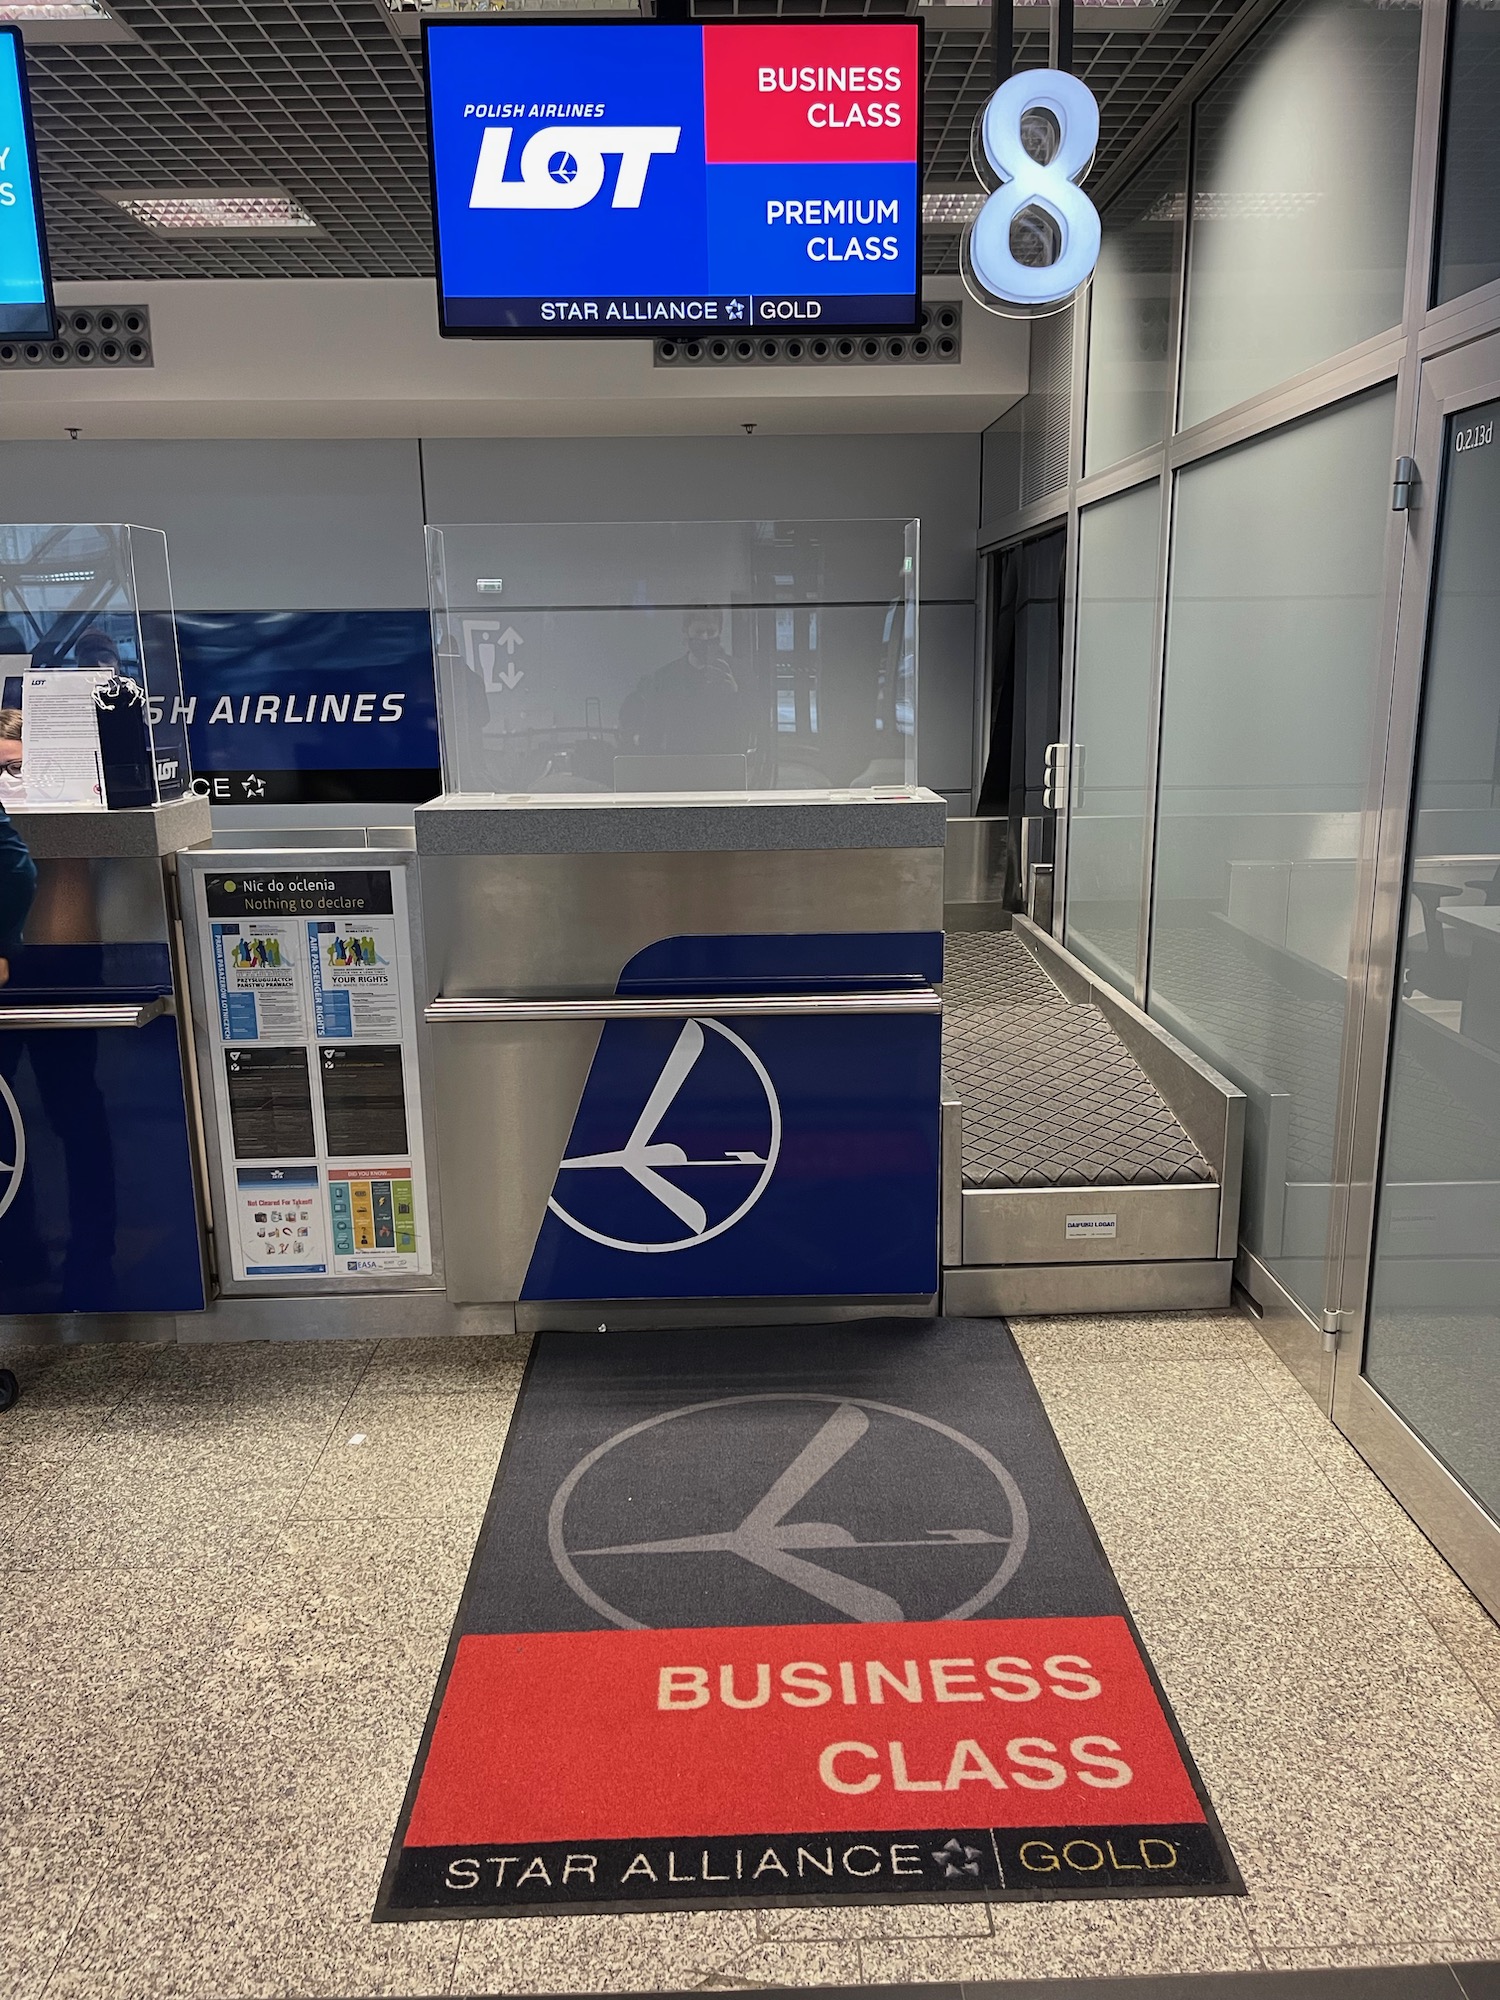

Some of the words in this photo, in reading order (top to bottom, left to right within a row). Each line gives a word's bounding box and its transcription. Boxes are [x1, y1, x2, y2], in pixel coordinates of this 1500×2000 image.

[758, 66, 902, 92] BUSINESS
[463, 103, 525, 118] POLISH
[528, 103, 606, 118] AIRLINES
[806, 102, 902, 128] CLASS
[468, 125, 682, 210] LOT
[970, 67, 1102, 305] 8
[766, 199, 899, 225] PREMIUM
[806, 235, 899, 261] CLASS
[540, 301, 600, 321] STAR
[605, 301, 719, 321] ALLIANCE
[759, 300, 822, 320] GOLD
[1455, 420, 1493, 452] 0.2.13d
[208, 692, 406, 724] AIRLINES
[242, 880, 265, 893] Nic
[267, 879, 285, 892] do
[288, 878, 336, 891] oclenia
[244, 897, 298, 913] Nothing
[300, 898, 314, 909] to
[317, 895, 365, 909] declare
[309, 936, 319, 952] AIR
[311, 953, 322, 1004] PASSENGER
[331, 976, 356, 984] YOUR
[358, 975, 389, 983] RIGHTS
[316, 1005, 326, 1036] RIGHTS
[357, 1261, 377, 1269] EASA
[657, 1654, 1102, 1711] BUSINESS
[818, 1735, 1134, 1795] CLASS
[445, 1853, 598, 1890] STAR
[620, 1843, 925, 1883] ALLIANCE
[1018, 1838, 1178, 1872] GOLD
